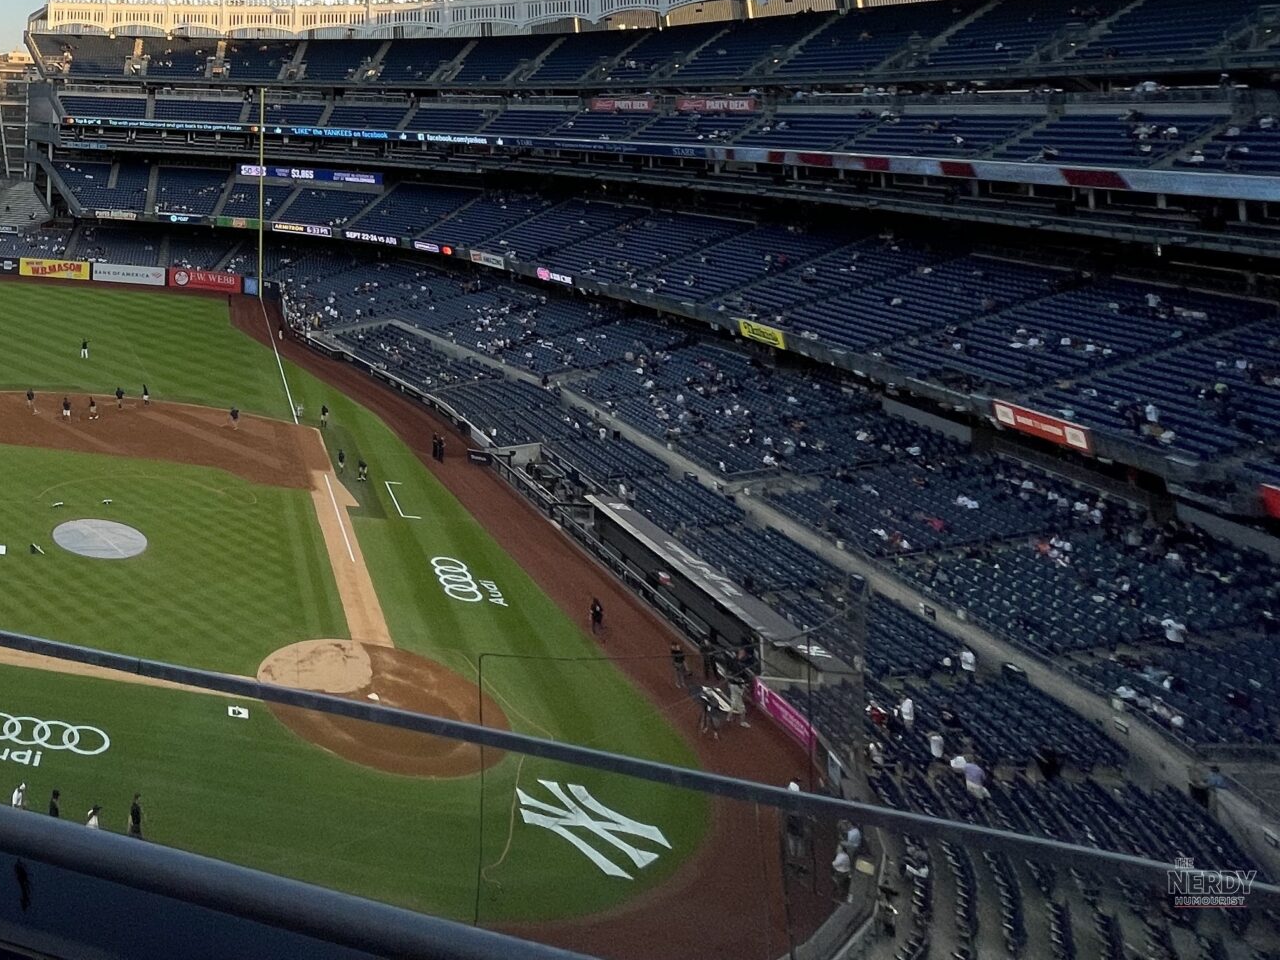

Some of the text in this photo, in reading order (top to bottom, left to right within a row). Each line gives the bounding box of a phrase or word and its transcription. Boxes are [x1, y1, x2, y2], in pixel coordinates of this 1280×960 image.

[706, 100, 727, 110] PARTY
[729, 101, 749, 110] DECK
[274, 223, 304, 232] ARMITRON
[346, 231, 361, 239] SEPT
[208, 274, 235, 285] WEBB
[479, 580, 509, 607] Audi
